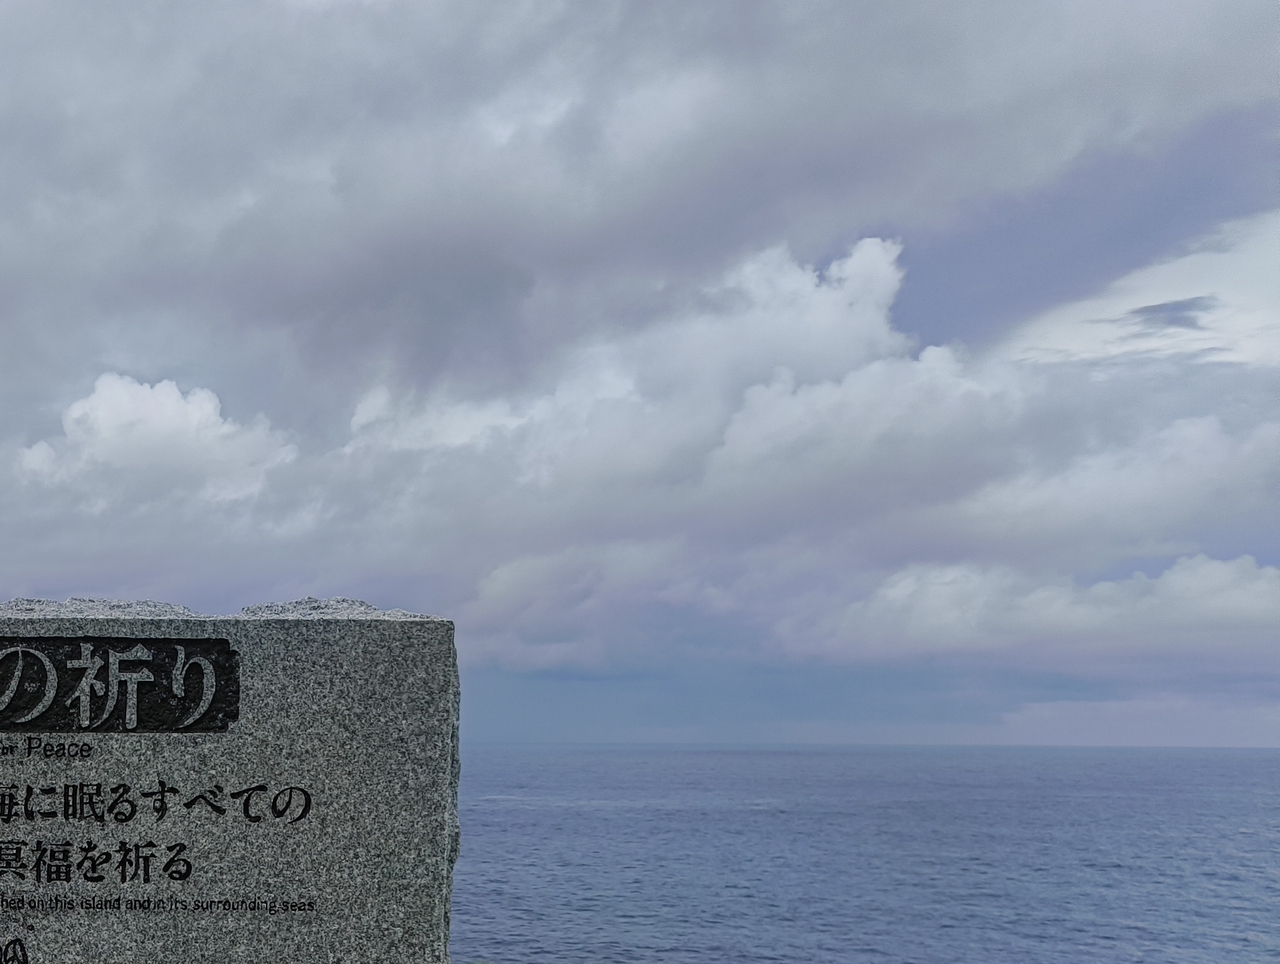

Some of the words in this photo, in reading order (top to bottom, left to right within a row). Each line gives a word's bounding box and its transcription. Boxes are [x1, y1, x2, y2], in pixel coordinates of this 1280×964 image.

[26, 736, 93, 758] Peace
[28, 899, 44, 911] on
[46, 895, 75, 911] this
[80, 895, 121, 911] island
[125, 897, 151, 911] and
[193, 896, 277, 916] surrounding
